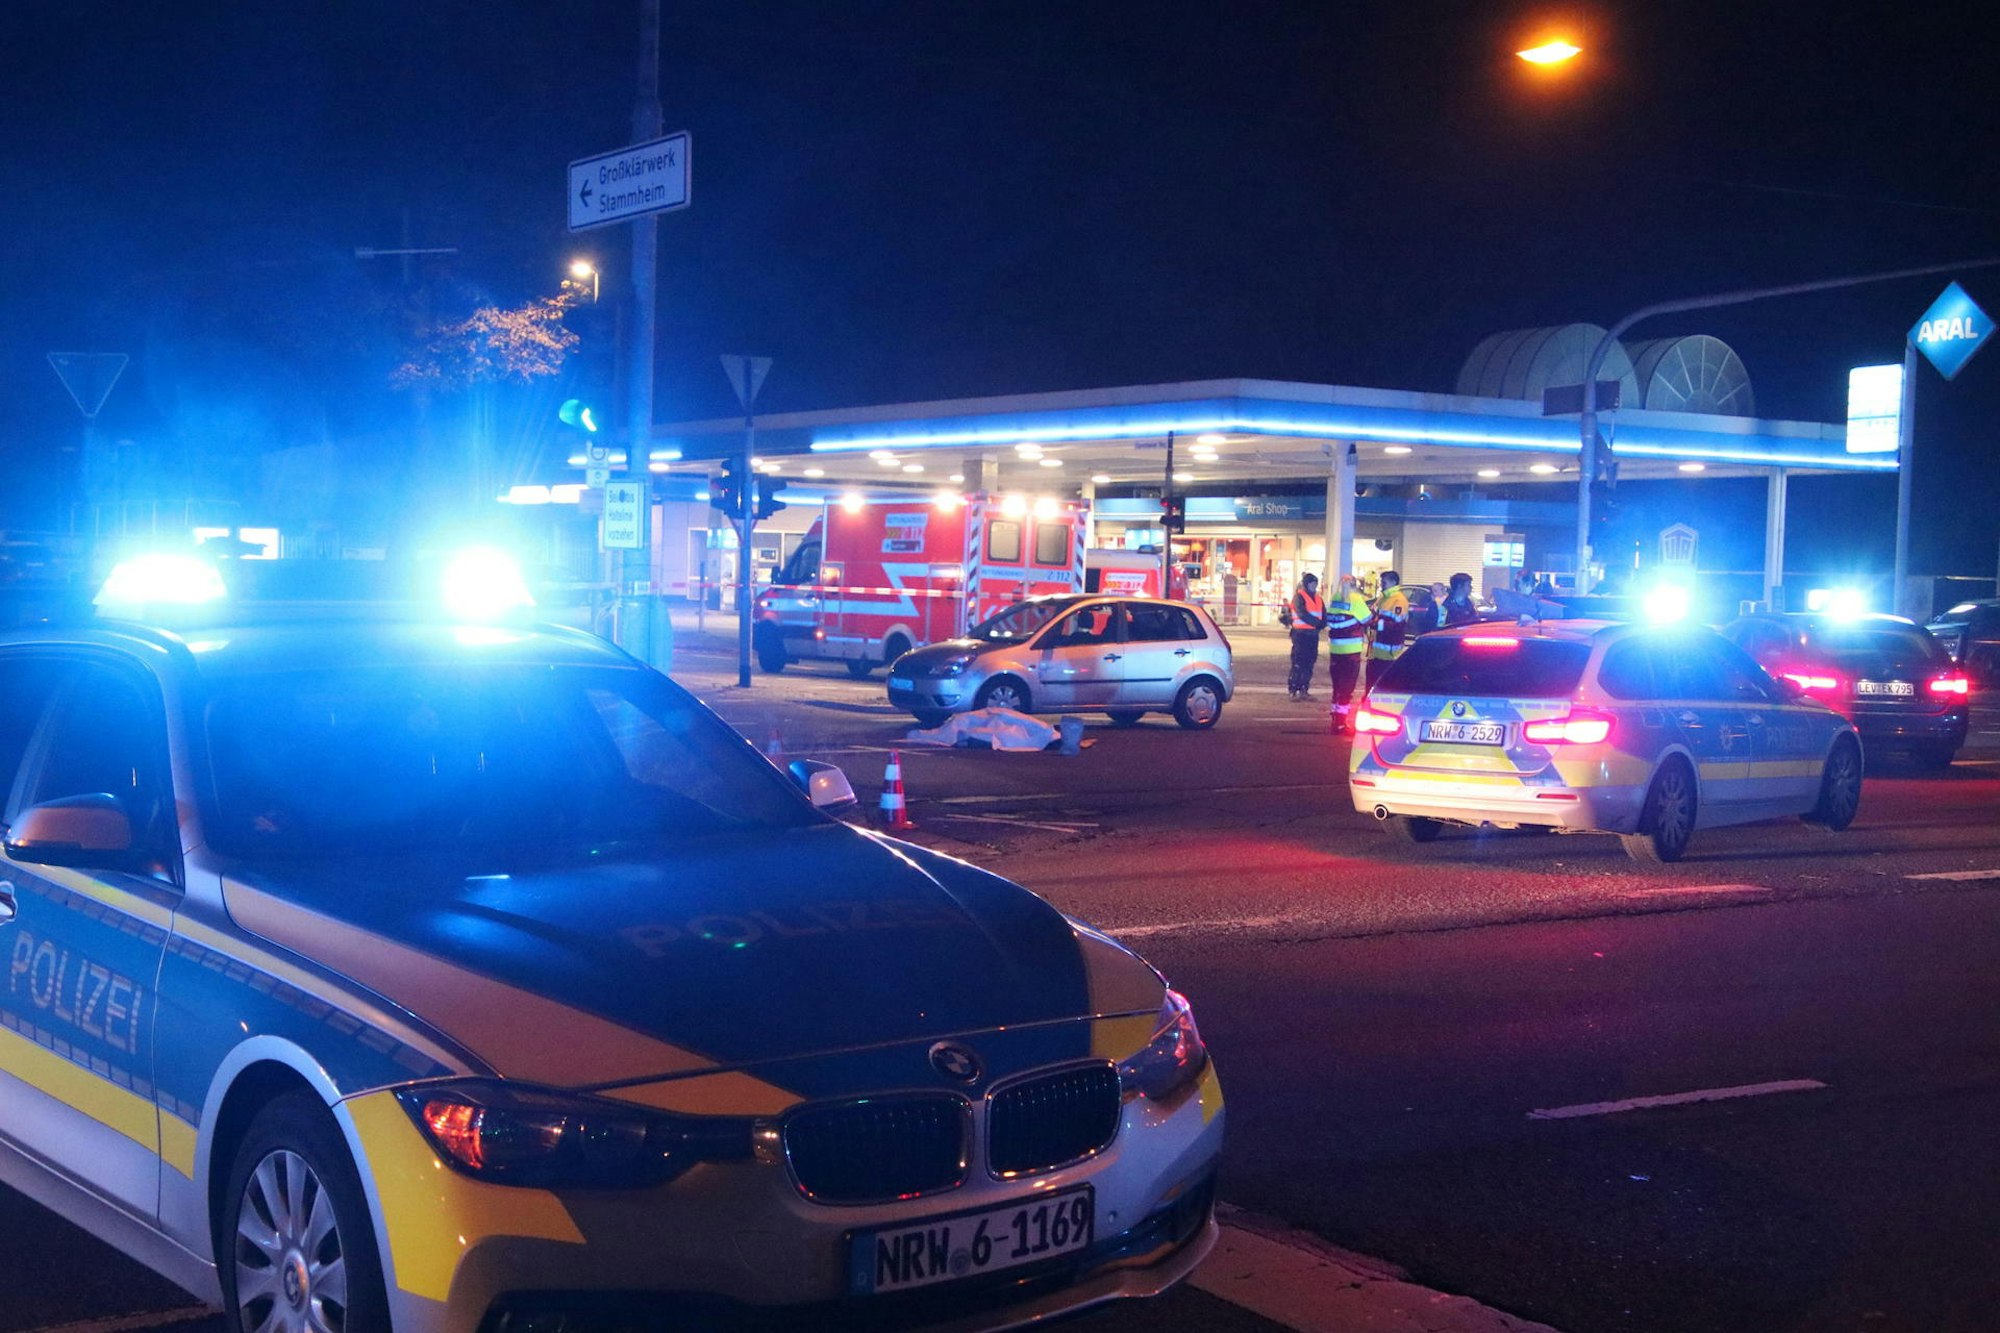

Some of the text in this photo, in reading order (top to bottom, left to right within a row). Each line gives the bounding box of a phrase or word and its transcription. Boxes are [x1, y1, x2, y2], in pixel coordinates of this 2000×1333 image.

[600, 148, 676, 184] Großklärwerk
[600, 184, 665, 213] Stammheim
[1917, 317, 1978, 342] ARAL
[1247, 502, 1288, 517] Aral Shop
[1056, 571, 1071, 582] 112
[1859, 683, 1876, 693] LEV
[1896, 684, 1913, 694] 795
[1428, 724, 1502, 741] NRW 6-2529
[10, 929, 142, 1055] POLIZEI
[877, 1196, 1088, 1287] NRW 6-1169
